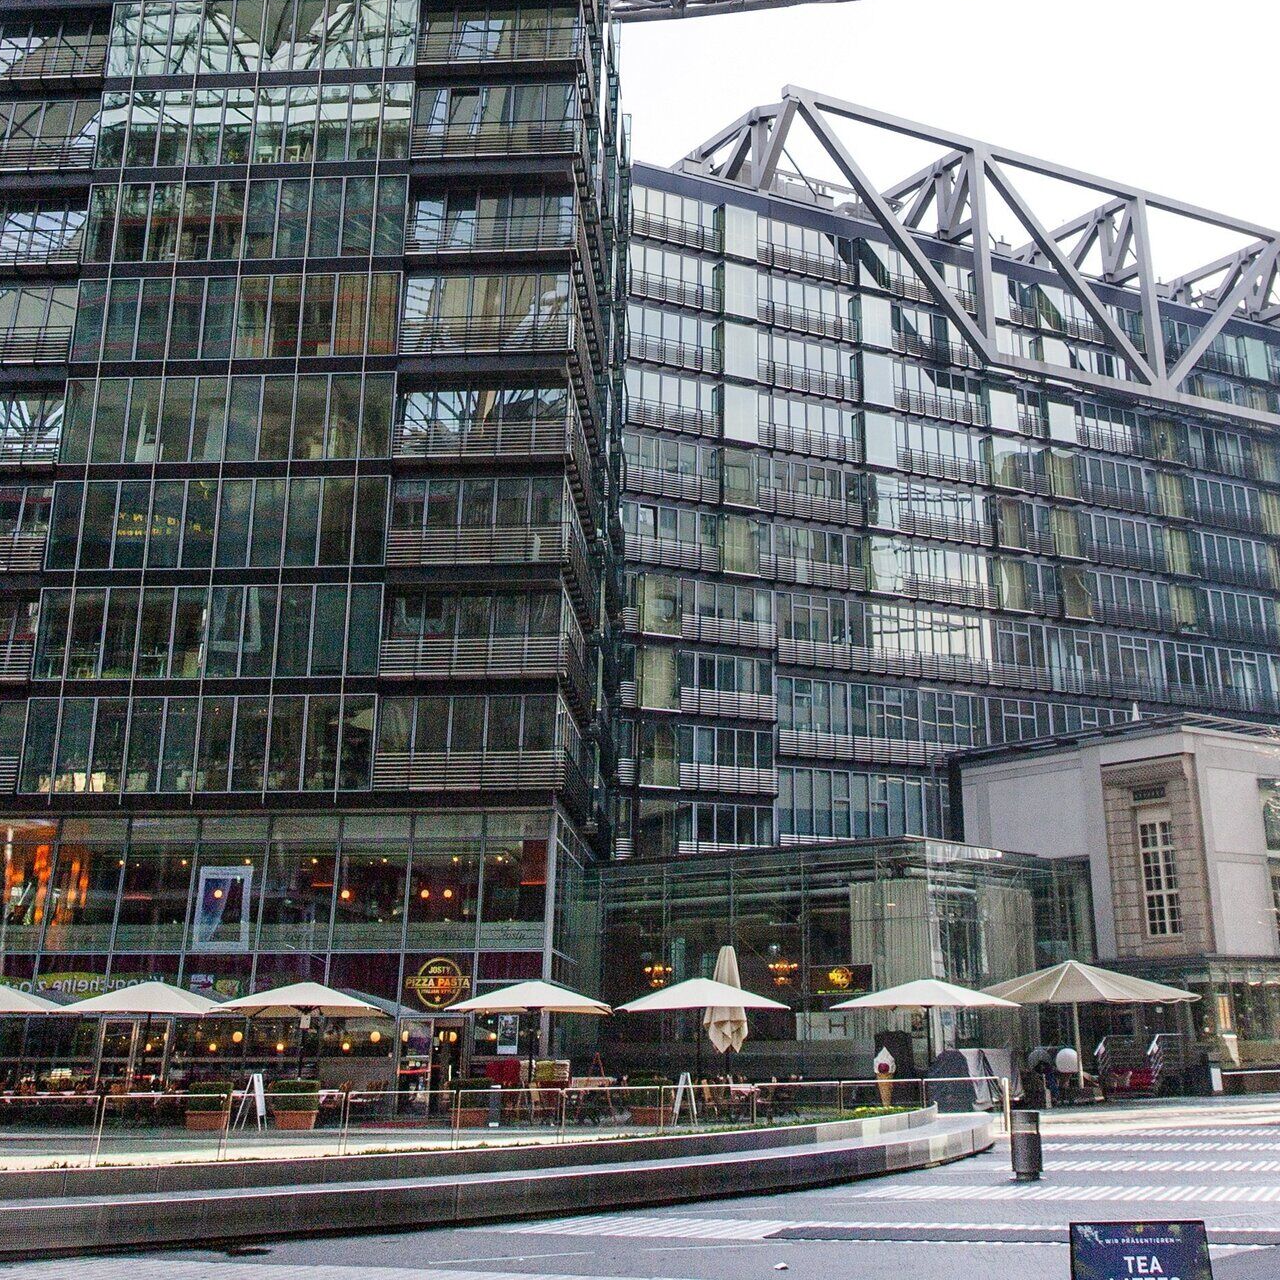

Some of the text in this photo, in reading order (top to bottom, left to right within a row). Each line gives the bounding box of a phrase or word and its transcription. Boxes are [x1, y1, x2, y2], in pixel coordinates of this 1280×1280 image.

[429, 966, 451, 974] JOSTY
[405, 978, 471, 988] PIZZA PASTA
[1123, 1255, 1164, 1274] TEA
